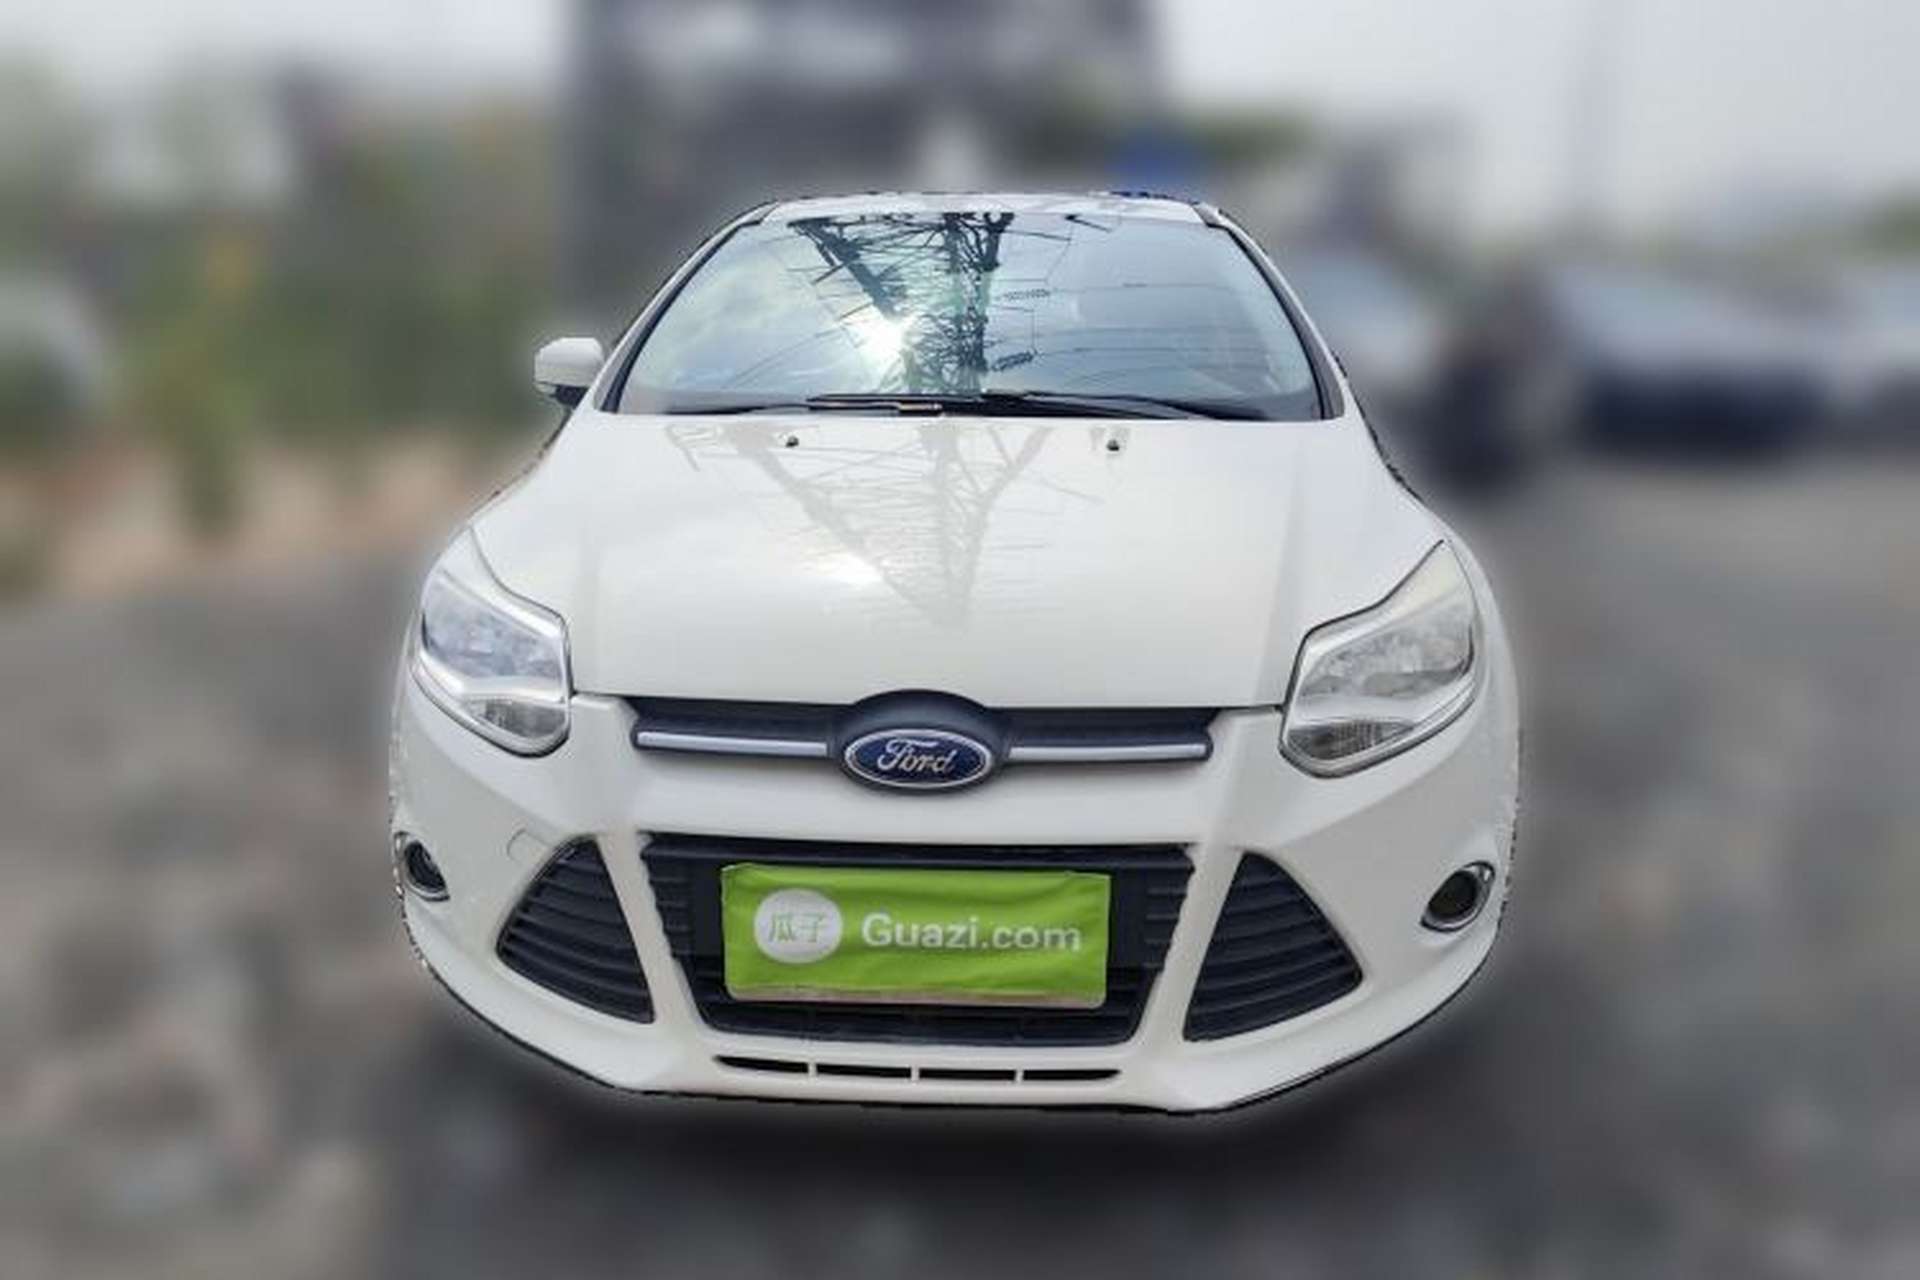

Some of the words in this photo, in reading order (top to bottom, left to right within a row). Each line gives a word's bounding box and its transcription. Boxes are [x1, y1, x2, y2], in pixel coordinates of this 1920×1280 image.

[877, 737, 957, 773] Ford
[766, 912, 826, 945] 瓜子
[861, 911, 1083, 952] Guazi.com
